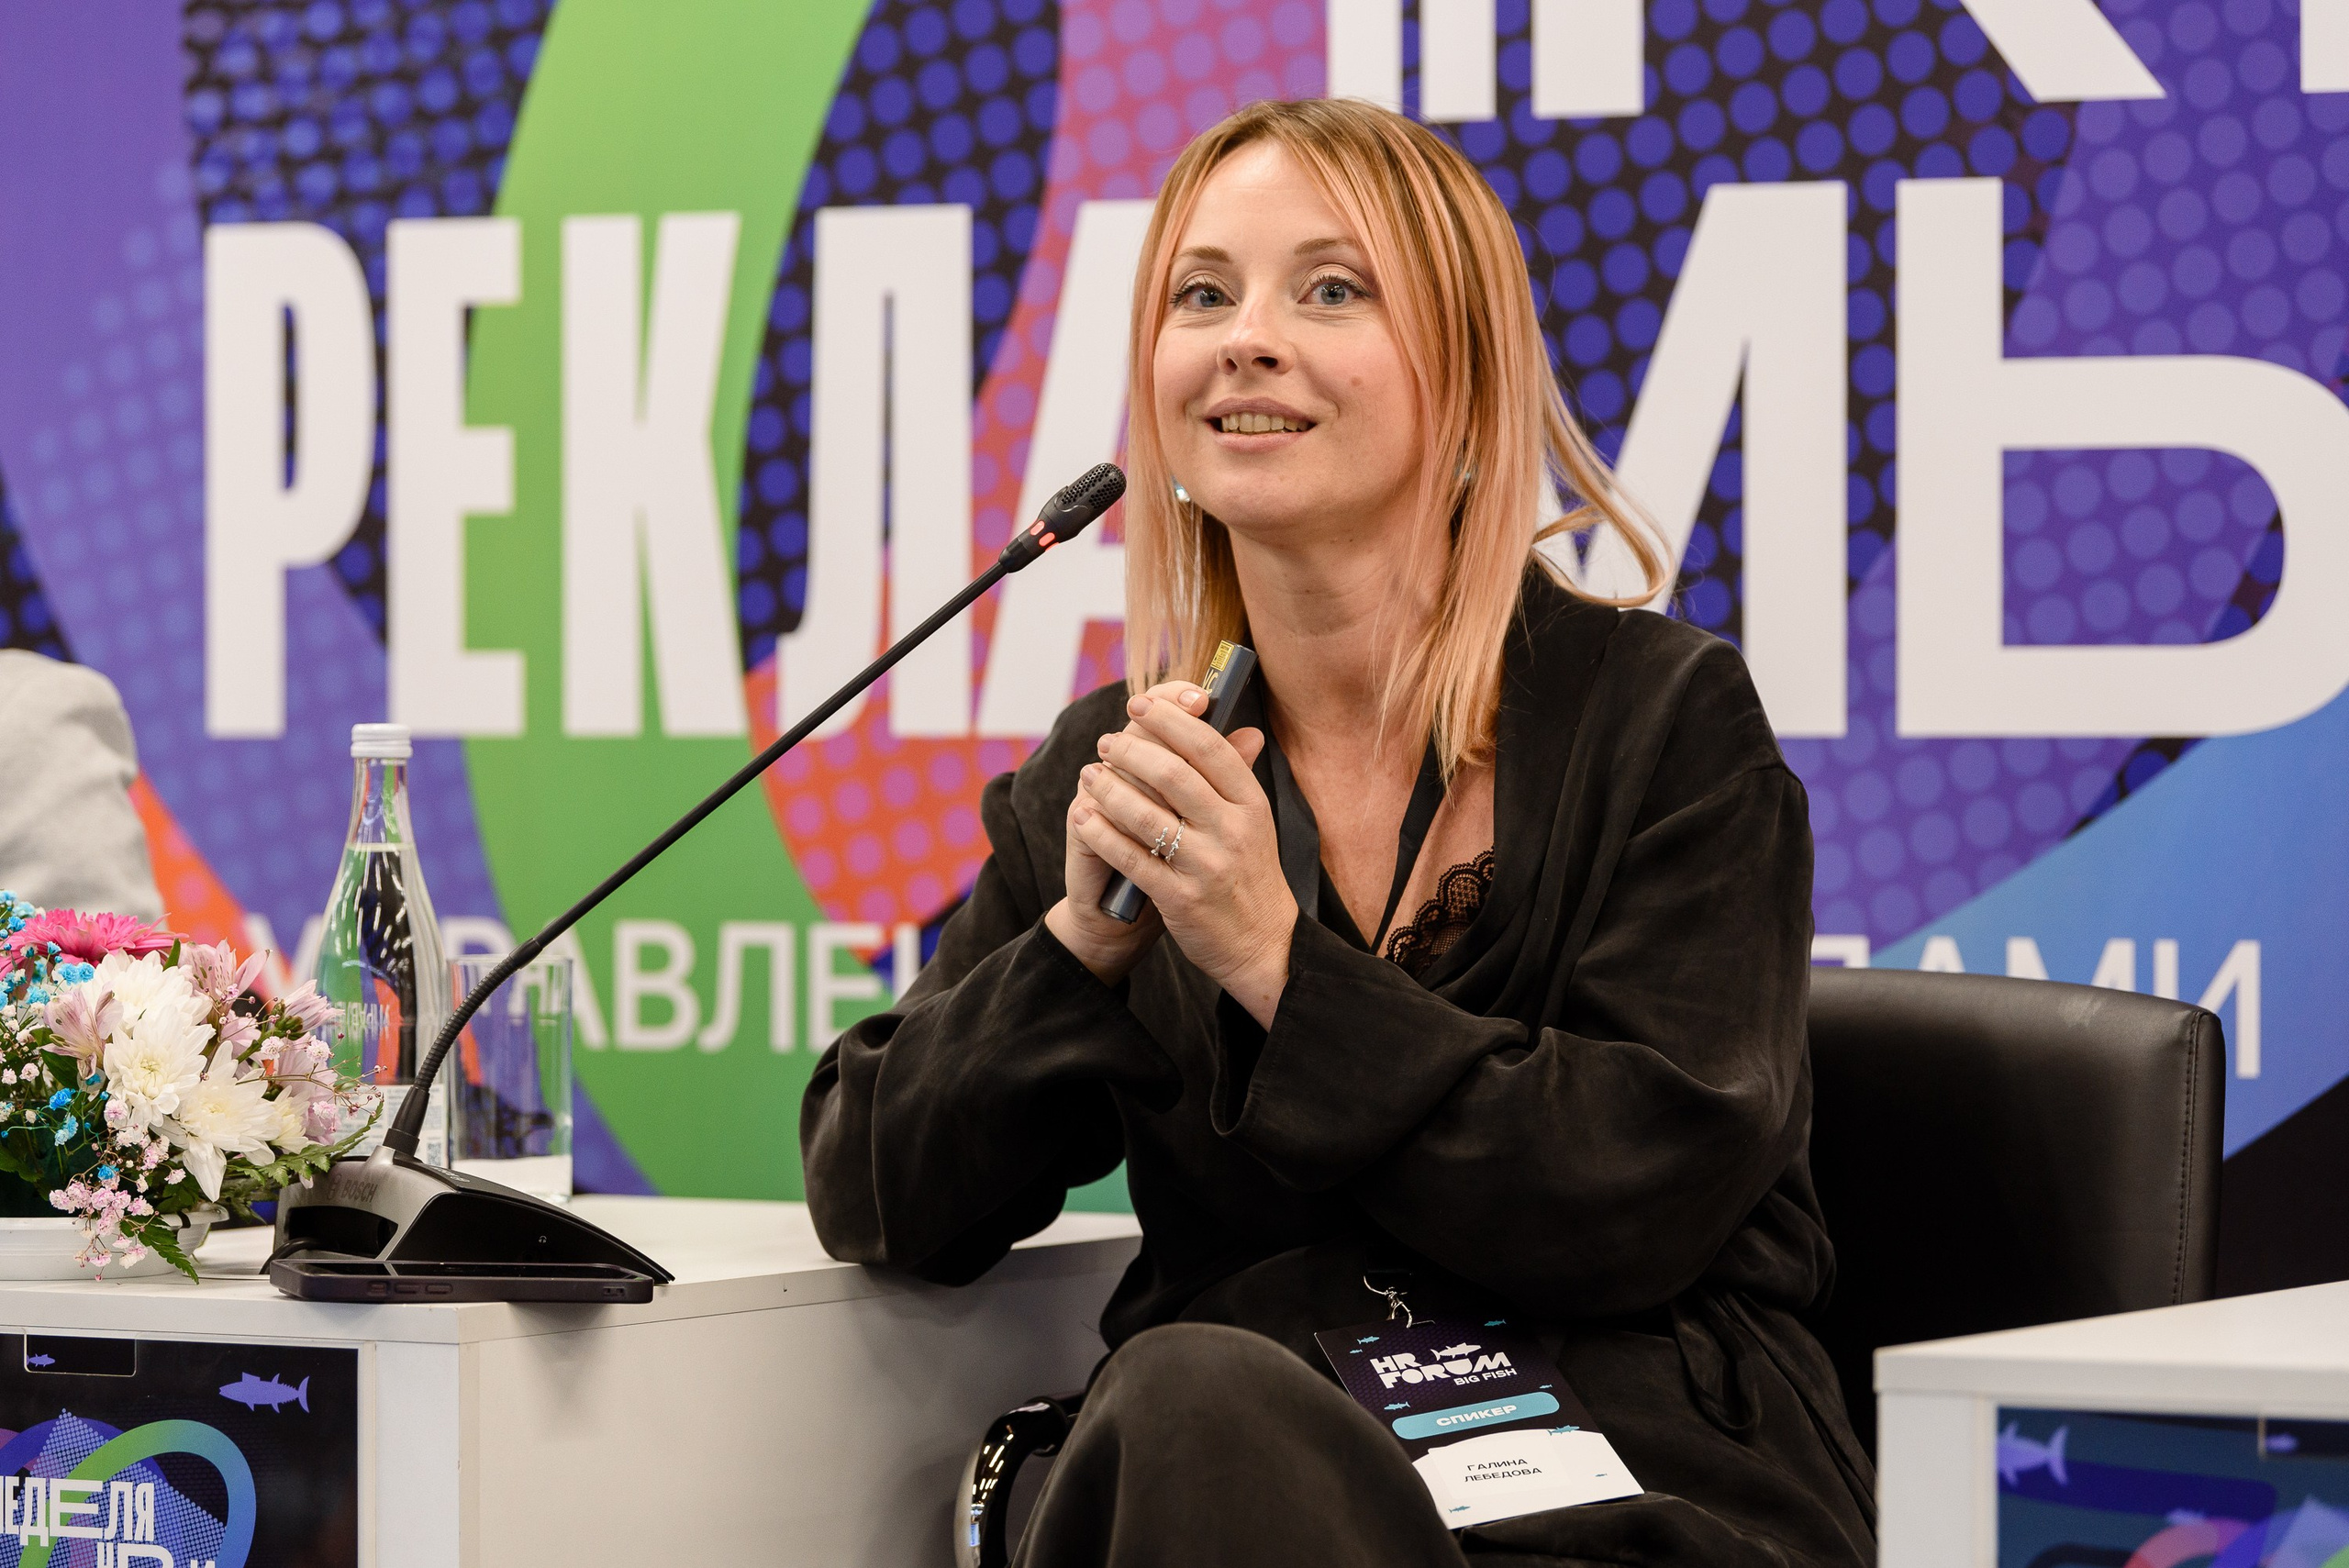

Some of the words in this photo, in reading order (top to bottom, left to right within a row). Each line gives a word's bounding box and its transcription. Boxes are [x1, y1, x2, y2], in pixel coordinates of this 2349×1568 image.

[343, 1179, 378, 1203] BOSCH
[1370, 1352, 1422, 1374] HR
[1379, 1351, 1512, 1389] FORUM
[1453, 1375, 1481, 1386] BIG
[1484, 1368, 1518, 1381] FISH
[1436, 1405, 1518, 1427] СПИКЕР
[1464, 1467, 1542, 1482] ЛЕБЕДОВА
[1466, 1458, 1528, 1471] ГАЛИНА
